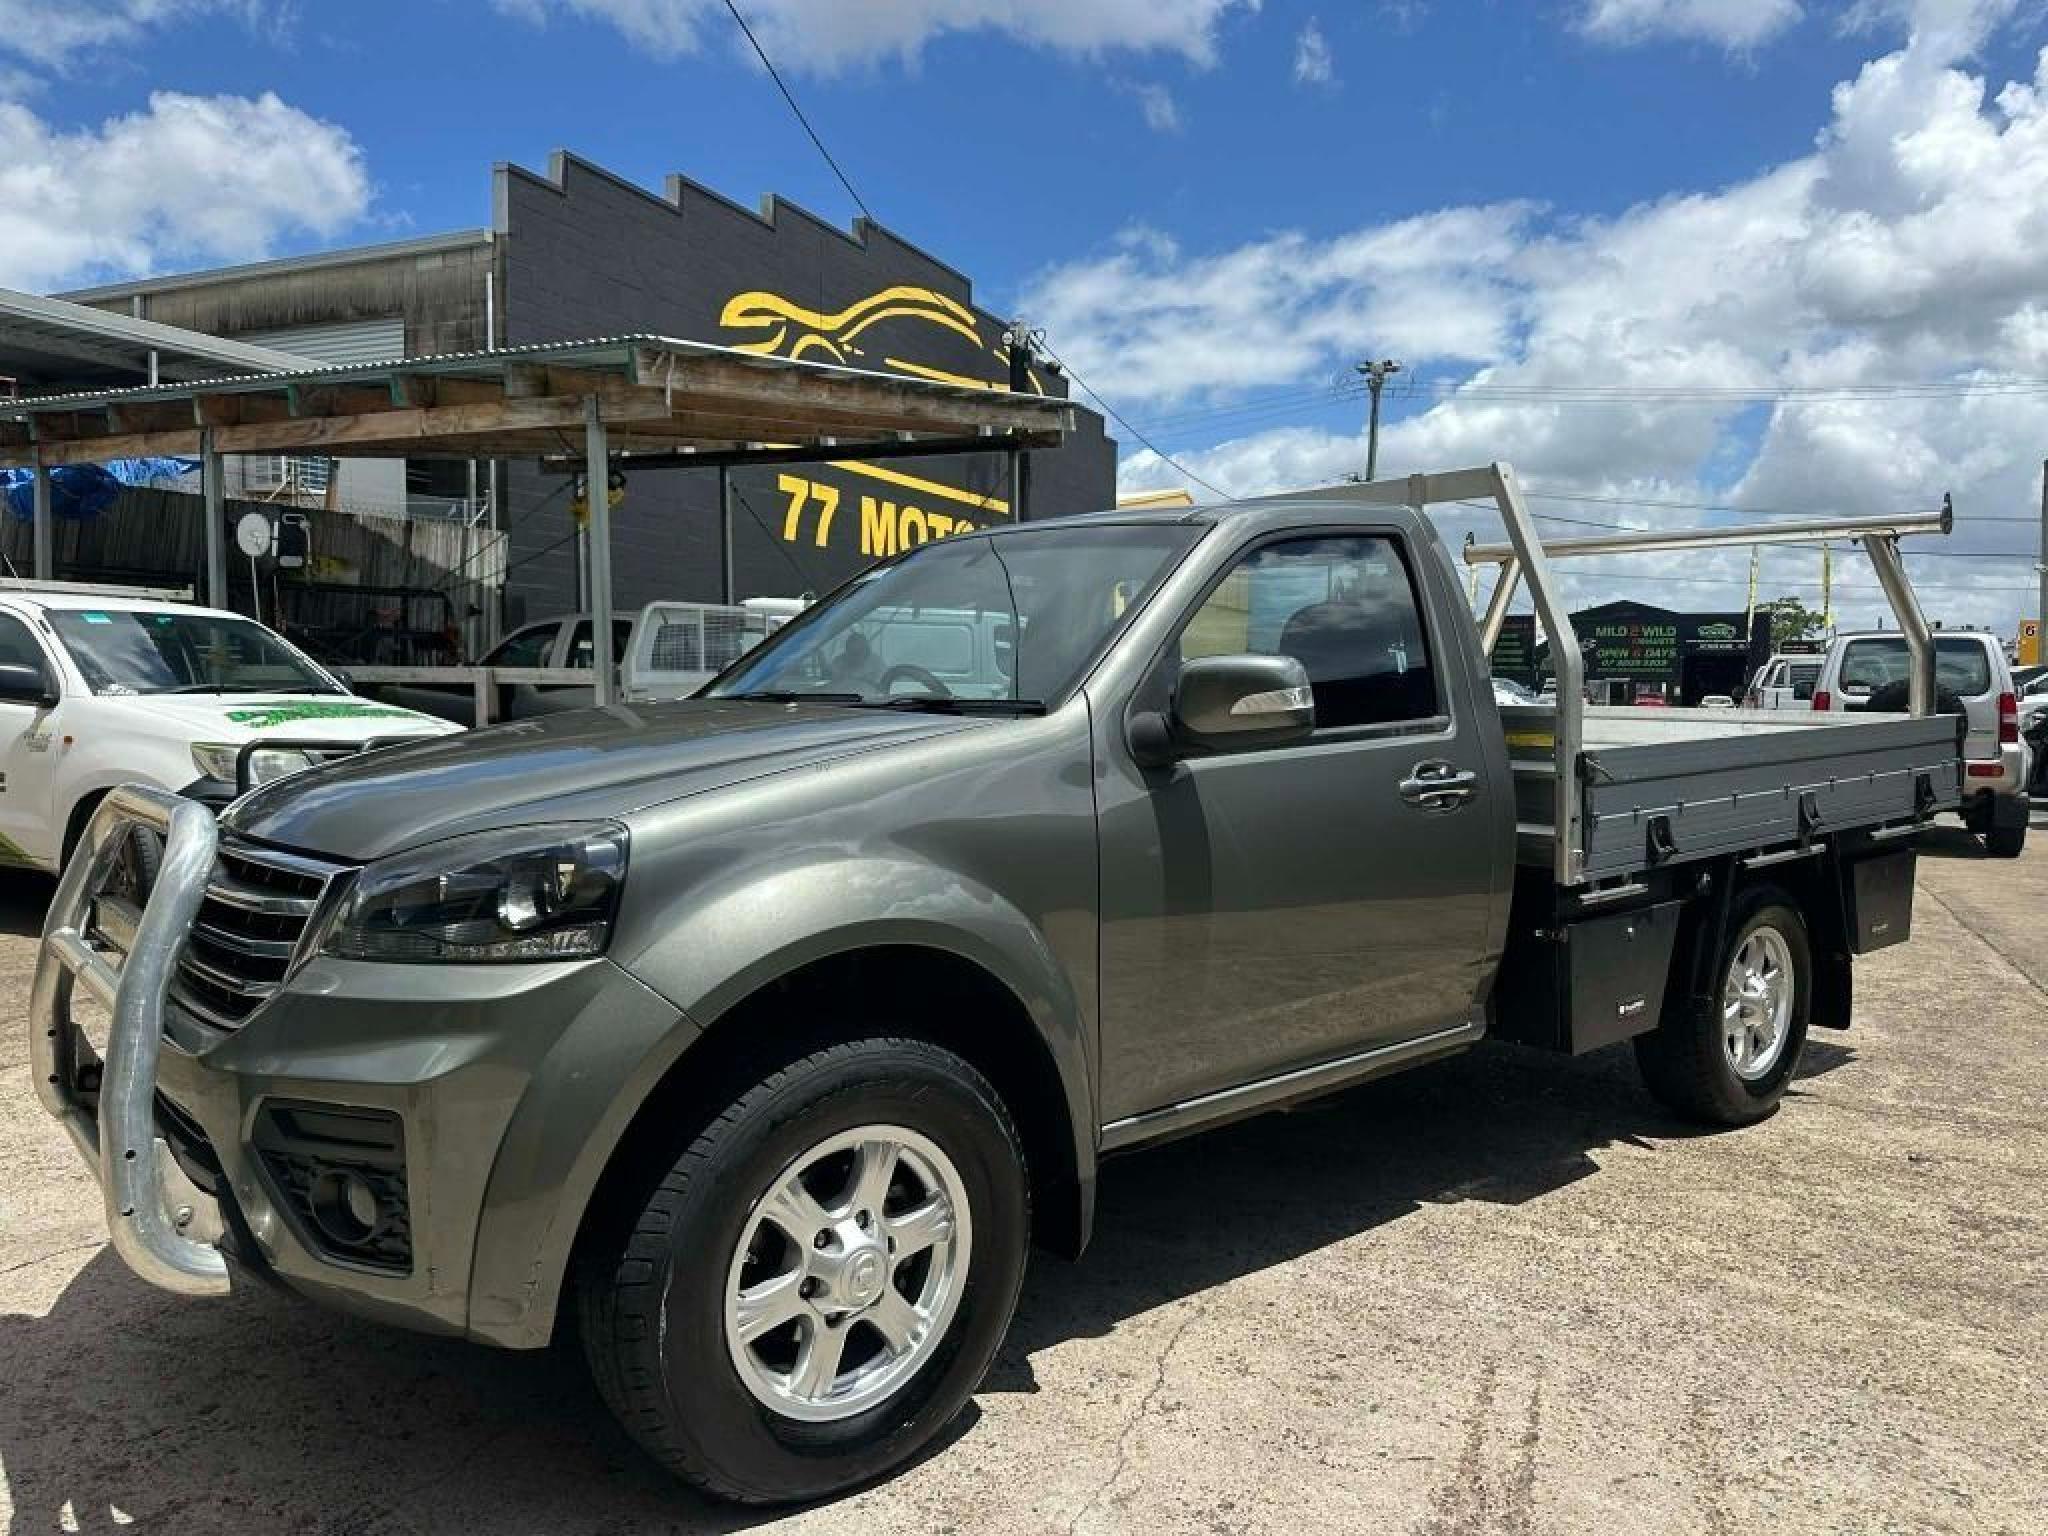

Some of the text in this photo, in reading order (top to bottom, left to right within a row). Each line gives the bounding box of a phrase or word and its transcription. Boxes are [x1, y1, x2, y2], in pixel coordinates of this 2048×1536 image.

[778, 473, 978, 557] 77 MOT
[1595, 626, 1627, 637] MILD
[1640, 626, 1677, 637] WILD
[1641, 647, 1677, 658] DAYS
